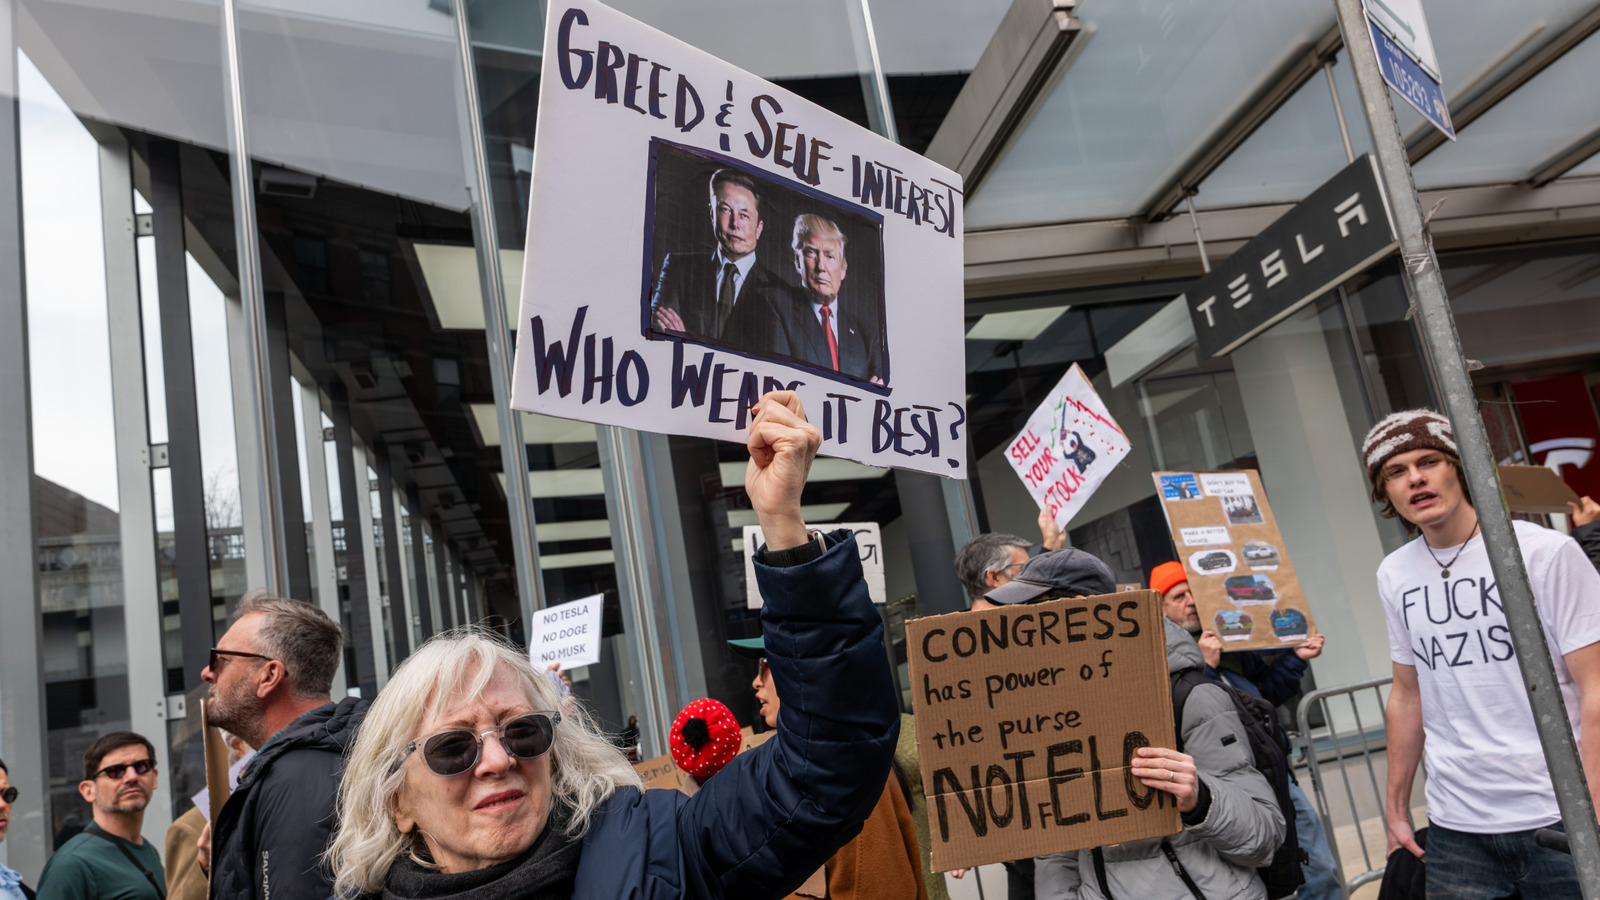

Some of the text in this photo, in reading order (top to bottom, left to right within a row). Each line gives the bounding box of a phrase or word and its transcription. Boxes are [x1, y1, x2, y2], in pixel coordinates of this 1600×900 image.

[557, 8, 705, 132] GREED
[1388, 57, 1432, 114] 105293
[1196, 192, 1369, 328] TESLA
[531, 306, 966, 469] WHO WEA IT BEST?
[1011, 429, 1041, 465] SELL
[1025, 447, 1059, 488] YOUR
[543, 604, 589, 625] NO TESLA
[1402, 577, 1504, 630] FUCK
[541, 643, 586, 662] NO MUSK
[542, 624, 588, 643] NO DOGE
[922, 600, 1140, 662] CONGRESS
[1412, 625, 1514, 670] NAZIS
[923, 650, 1113, 708] has power of
[932, 710, 1082, 750] the purse
[933, 750, 1036, 842] NOT
[261, 850, 270, 900] SALOM
